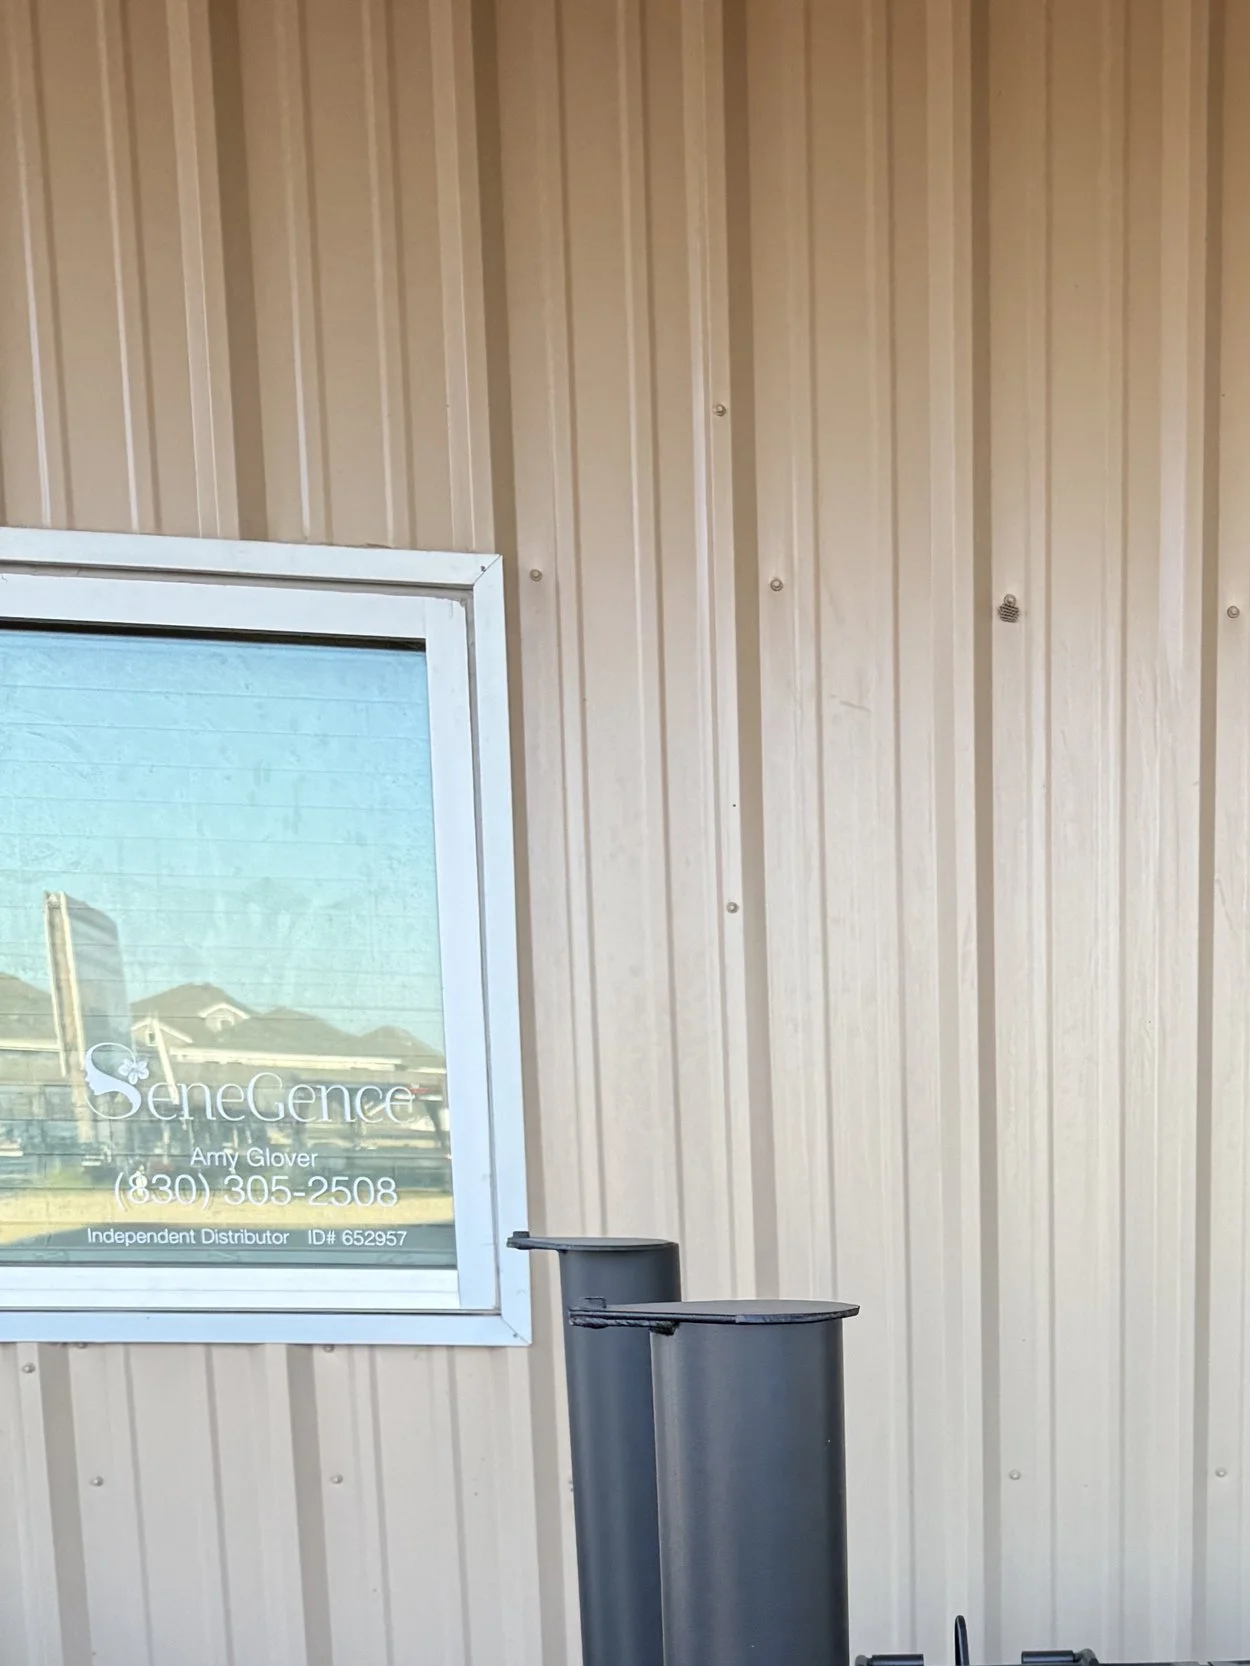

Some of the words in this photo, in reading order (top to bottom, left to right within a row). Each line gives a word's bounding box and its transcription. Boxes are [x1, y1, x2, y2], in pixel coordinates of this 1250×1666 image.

[84, 1042, 415, 1124] SeneGence
[190, 1148, 239, 1174] Amy
[246, 1148, 318, 1169] Glover
[114, 1171, 211, 1211] (830)
[223, 1174, 399, 1208] 305-2508
[87, 1227, 196, 1248] Independent
[201, 1228, 290, 1247] Distributor
[307, 1229, 337, 1247] ID#
[342, 1229, 408, 1247] 652957
